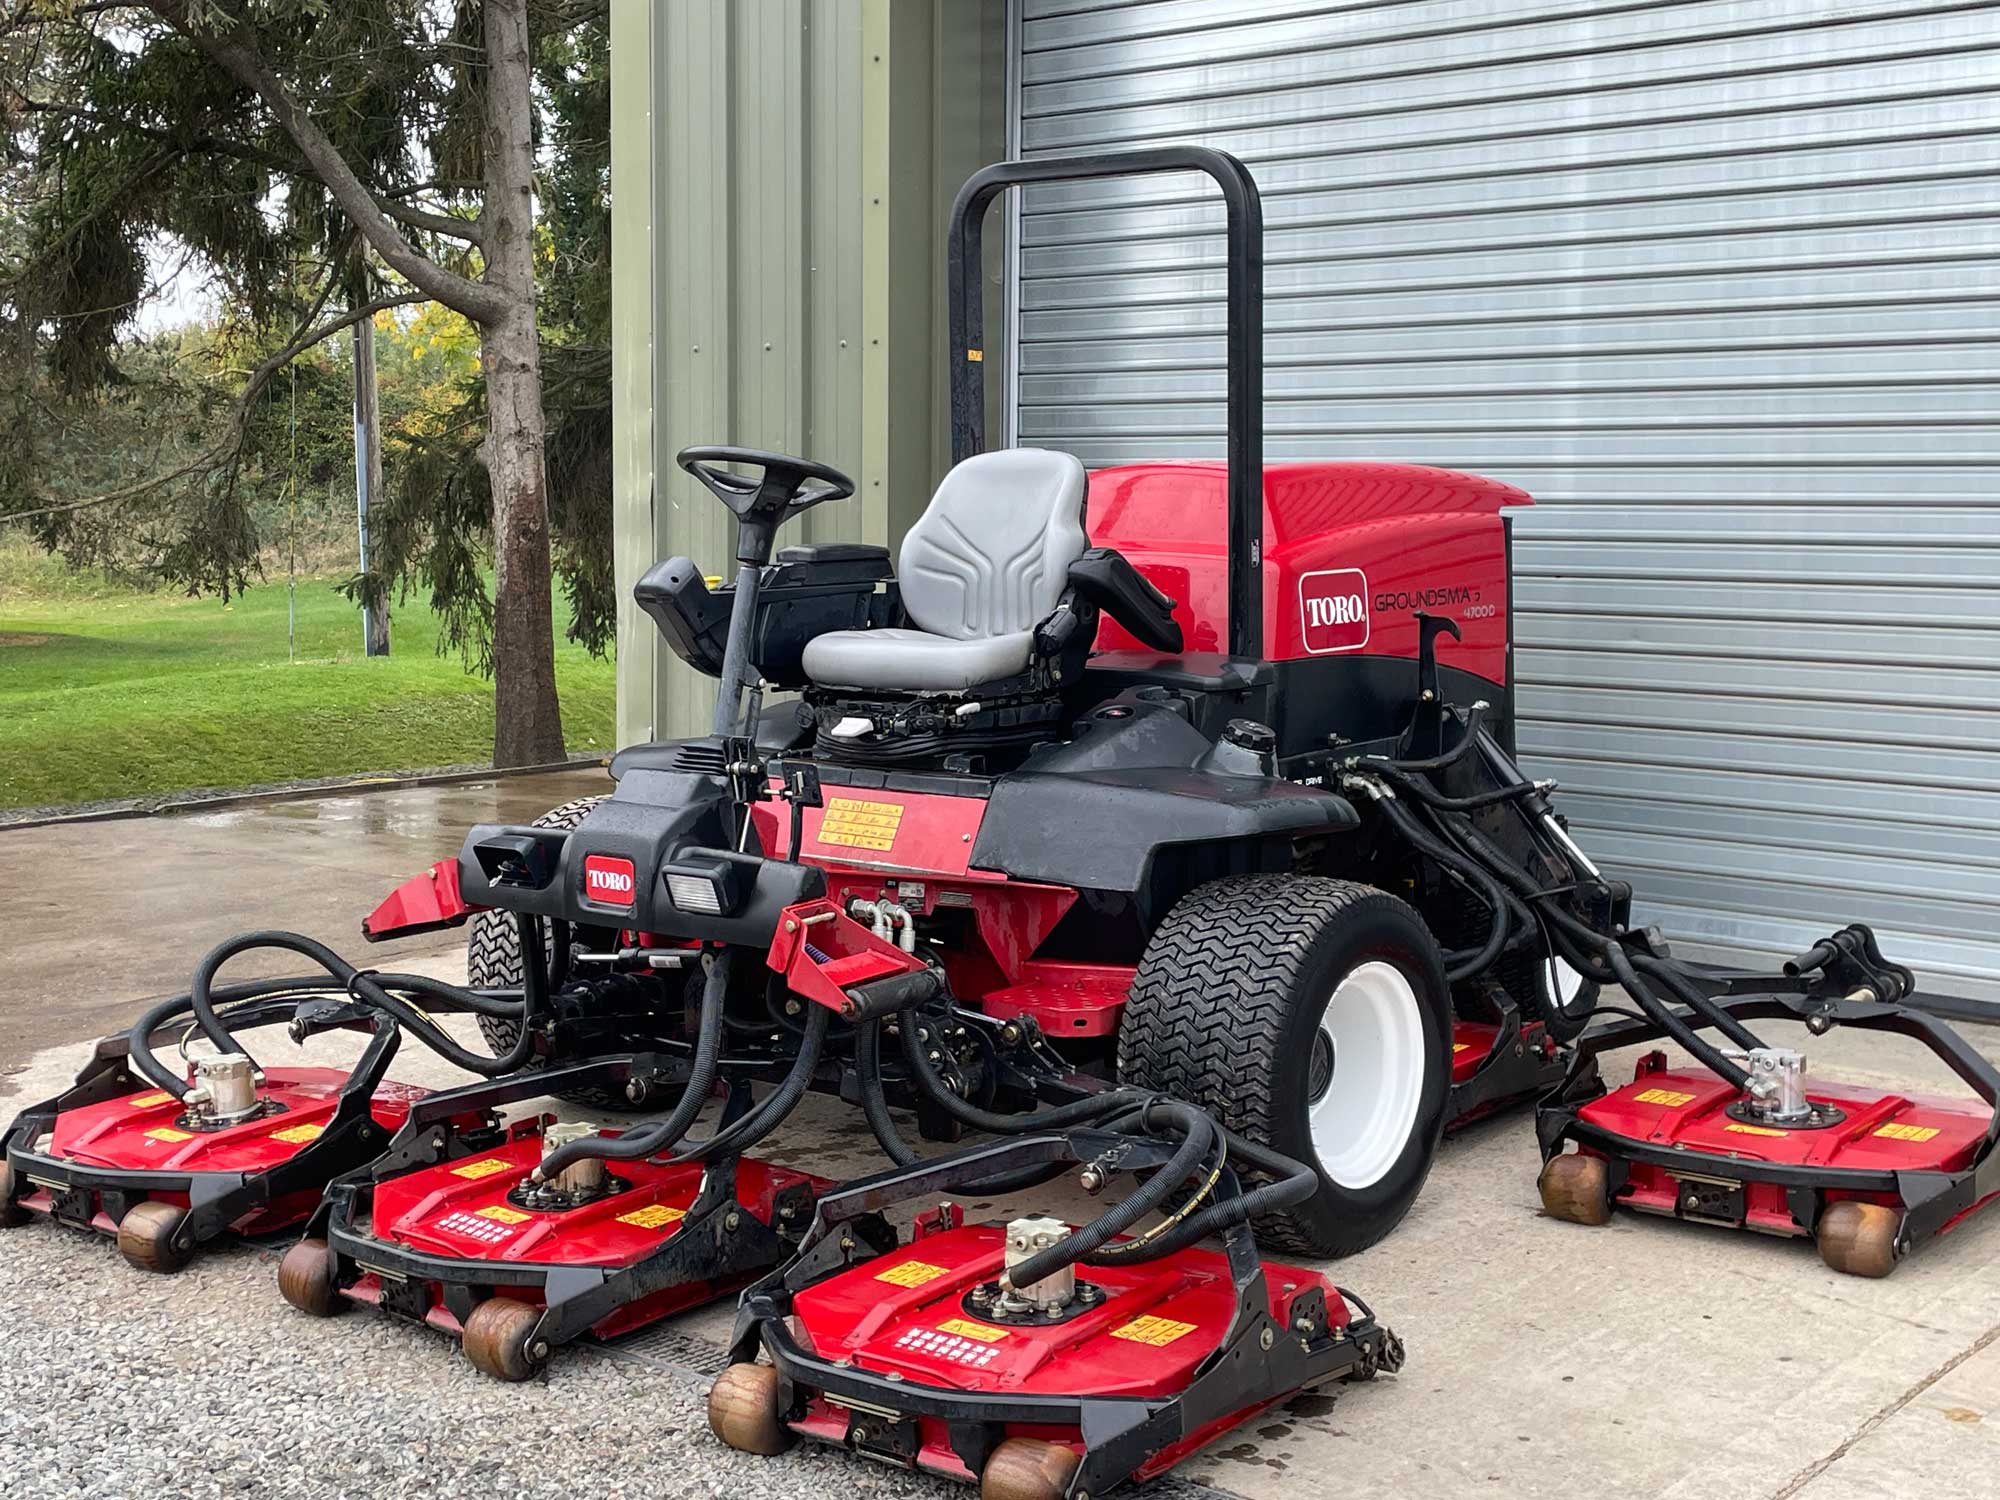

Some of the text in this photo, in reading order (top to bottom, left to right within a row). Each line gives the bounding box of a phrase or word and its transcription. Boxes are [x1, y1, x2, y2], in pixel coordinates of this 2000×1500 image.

[1306, 594, 1364, 628] TORO
[1305, 776, 1323, 786] DRIVE
[588, 870, 632, 892] TORO
